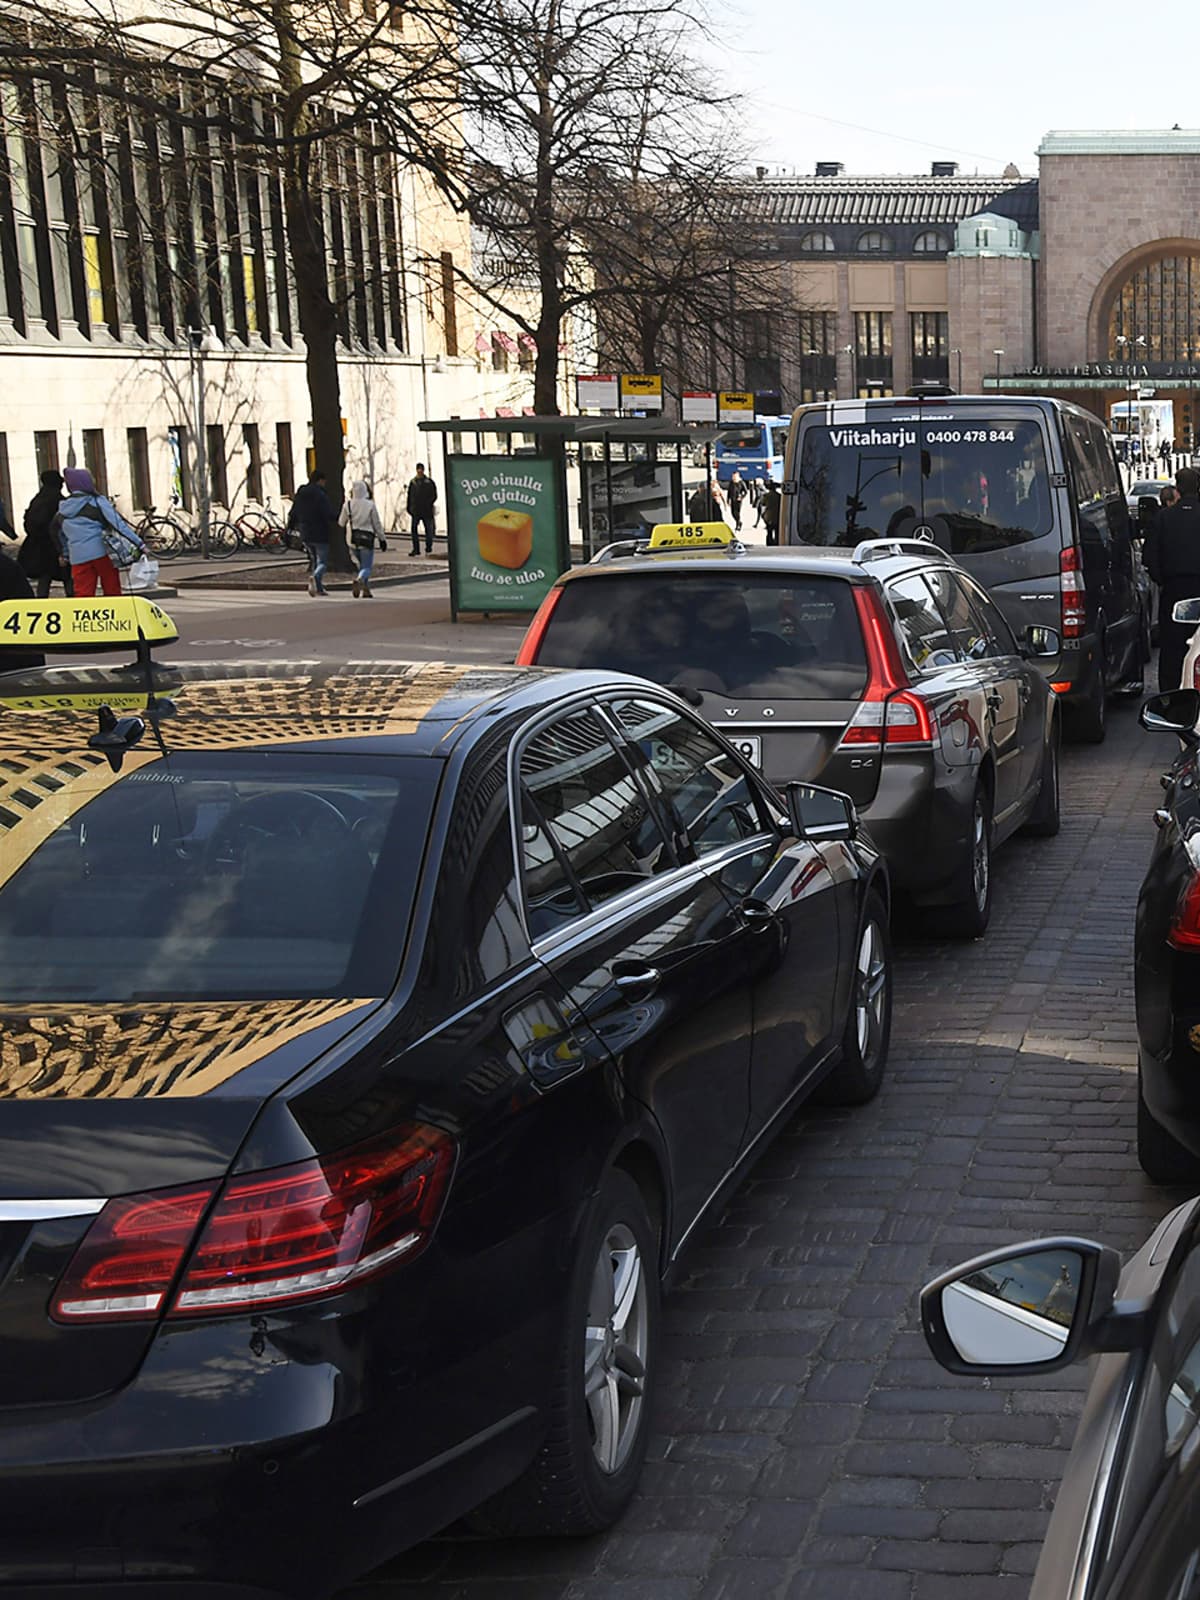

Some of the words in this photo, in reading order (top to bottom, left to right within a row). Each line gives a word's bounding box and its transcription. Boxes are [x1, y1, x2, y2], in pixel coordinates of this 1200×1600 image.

[829, 428, 916, 448] Viitaharju
[926, 431, 961, 443] 0400
[963, 430, 987, 443] 478
[989, 430, 1015, 442] 844
[461, 477, 488, 495] Jos
[491, 472, 543, 492] sinulla
[470, 493, 489, 506] on
[492, 488, 537, 506] ajatus
[677, 526, 704, 537] 185
[470, 566, 493, 583] tuo
[496, 574, 513, 585] se
[516, 568, 546, 585] ulos
[3, 611, 62, 635] 478
[73, 609, 115, 621] TAKSI
[72, 620, 132, 633] HELSINKI
[128, 772, 186, 784] nothing.
